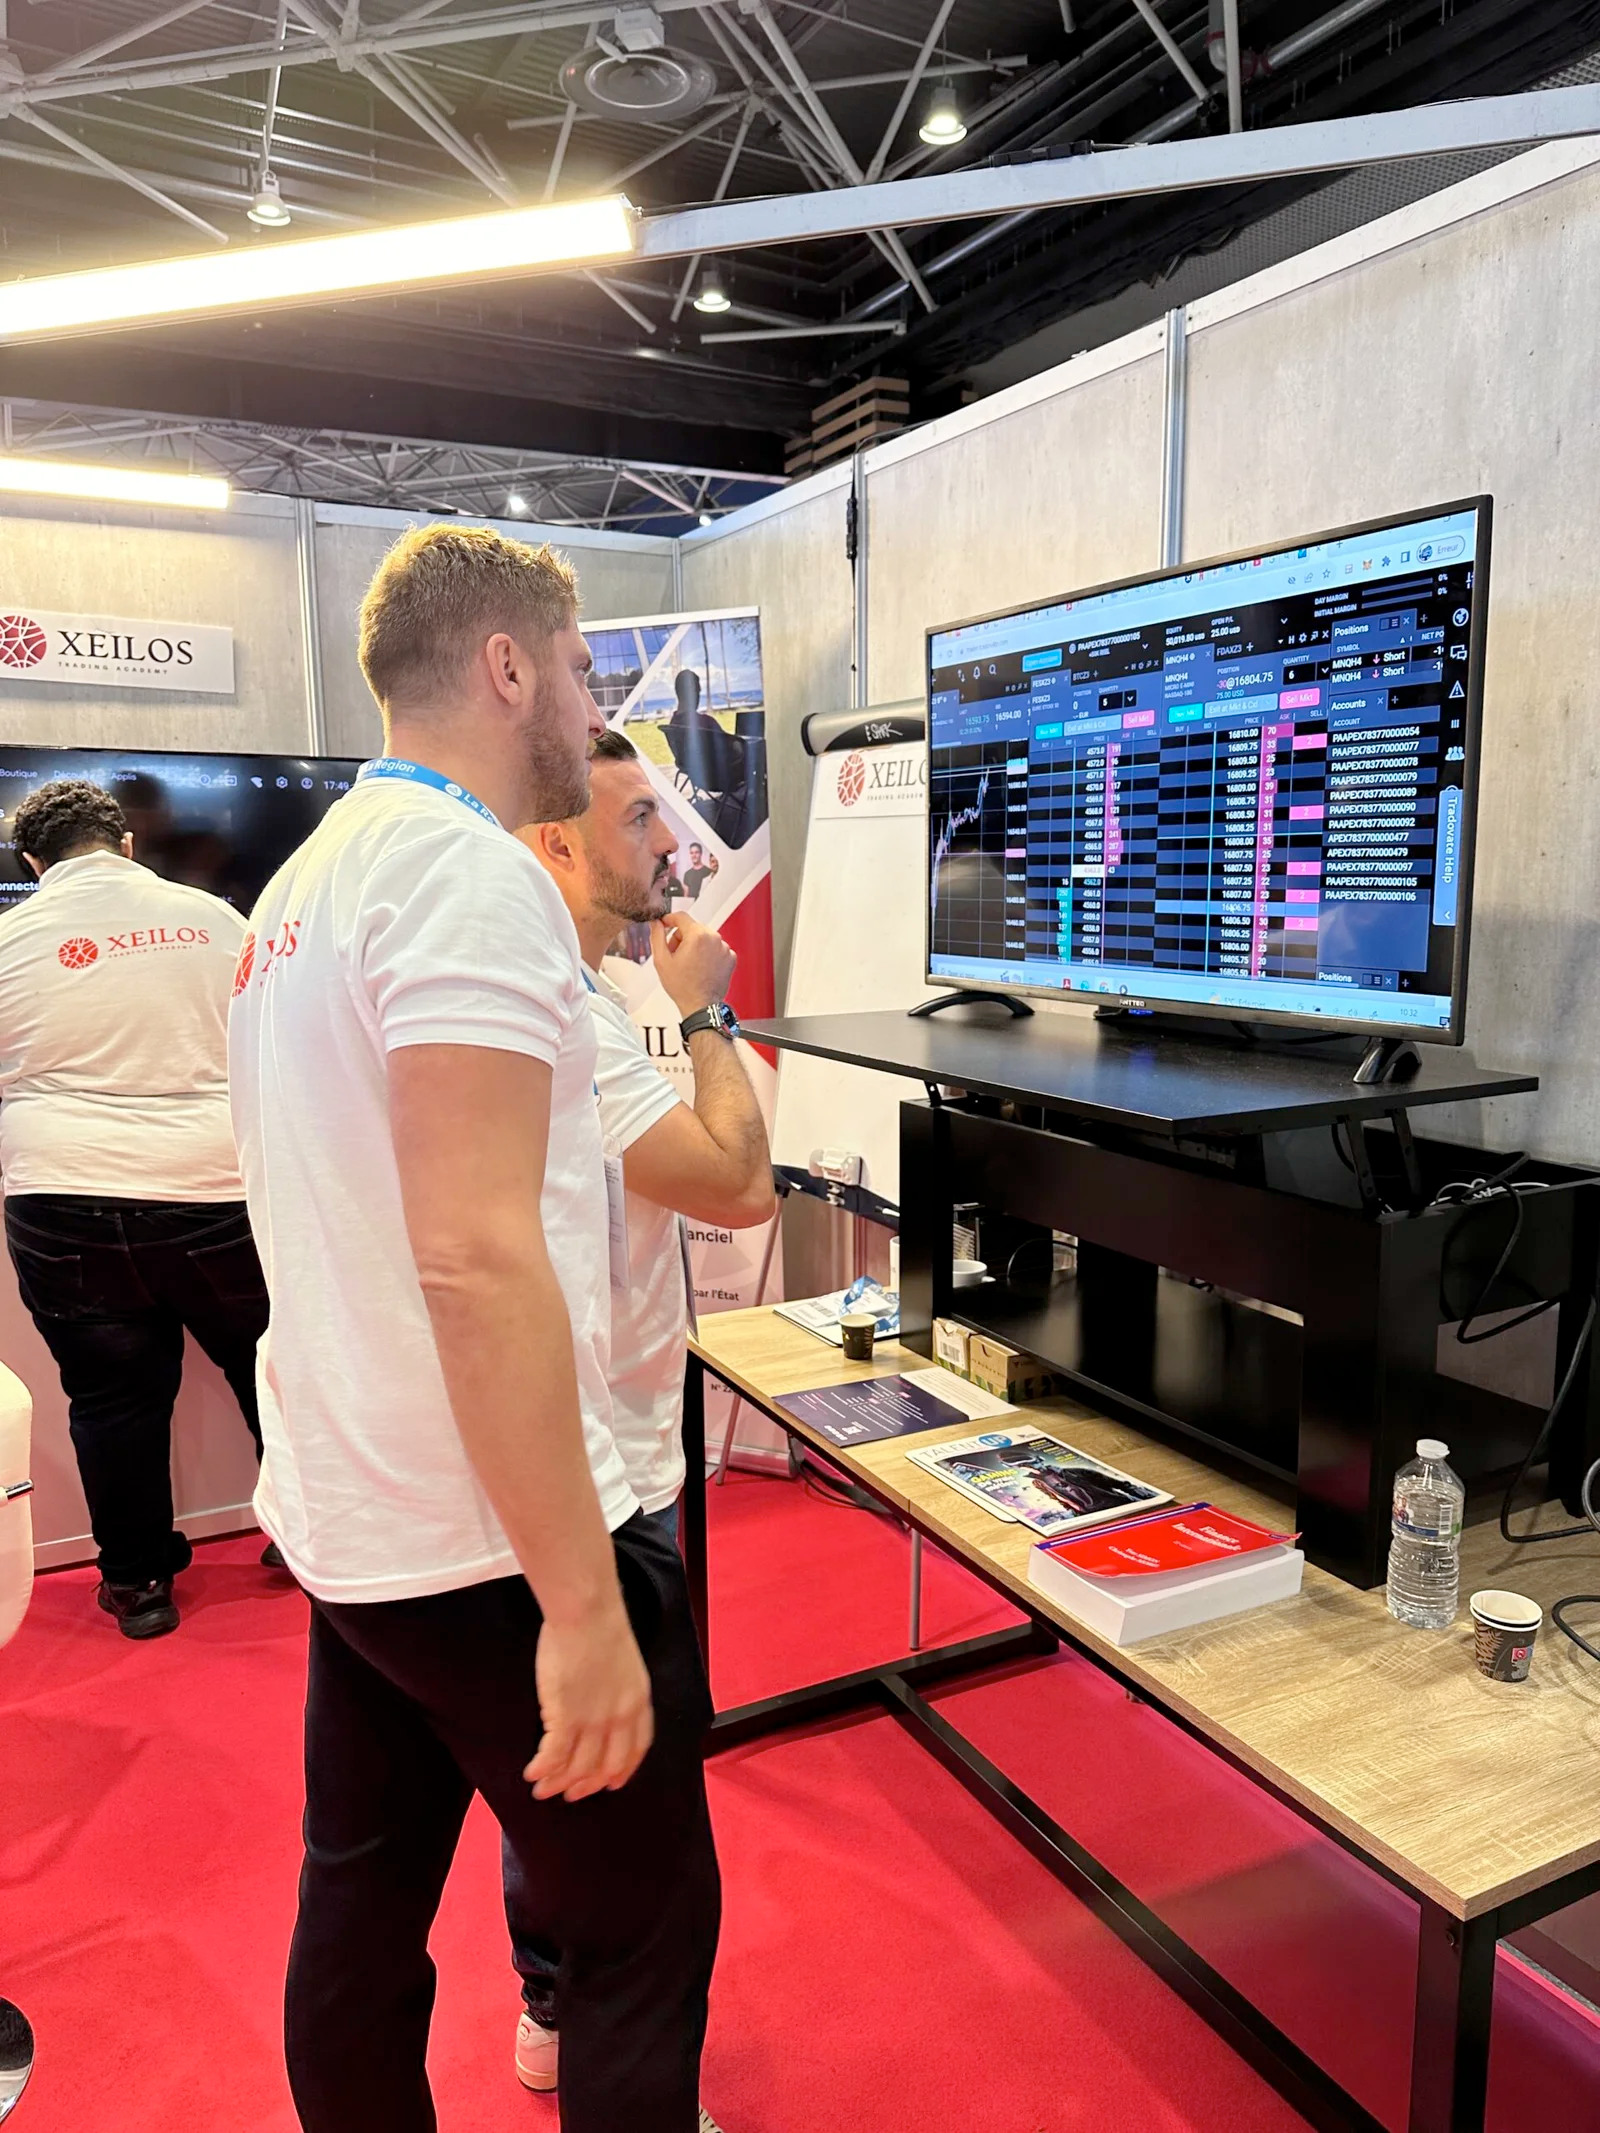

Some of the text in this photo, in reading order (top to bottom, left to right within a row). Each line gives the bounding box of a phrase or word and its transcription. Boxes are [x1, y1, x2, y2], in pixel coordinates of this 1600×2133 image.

[1326, 592, 1349, 603] MARGIN
[1314, 603, 1357, 617] INITIAL MARGIN
[1211, 627, 1229, 638] 25.00
[1334, 624, 1369, 637] Positions
[1422, 632, 1434, 641] NET
[57, 630, 194, 665] XEILOS
[1216, 645, 1242, 657] FDAXZ3
[1337, 644, 1360, 653] SYMBOL
[1166, 654, 1189, 665] MNQH4
[1283, 655, 1310, 665] QUANTITY
[1332, 651, 1406, 669] MNQH4 Short
[58, 662, 168, 675] TRADING ACADEMY
[1217, 666, 1240, 675] POSITION
[1165, 672, 1188, 683] MNQH4
[1288, 670, 1295, 679] 6
[1332, 666, 1405, 684] MNQH4 Short
[1232, 689, 1244, 698] USD
[1286, 694, 1298, 704] Sell
[1331, 700, 1366, 711] Accounts
[1244, 717, 1259, 725] PRICE
[1310, 709, 1323, 717] SELL
[1333, 717, 1360, 727] ACCOUNT
[373, 760, 416, 774] Région
[0, 769, 38, 779] Boutique
[323, 780, 350, 790] 17:49
[463, 794, 479, 809] La
[1442, 796, 1458, 884] Tradovate Help
[107, 927, 210, 951] XEILOS
[1318, 972, 1353, 983] Positions
[982, 1435, 1008, 1447] UP
